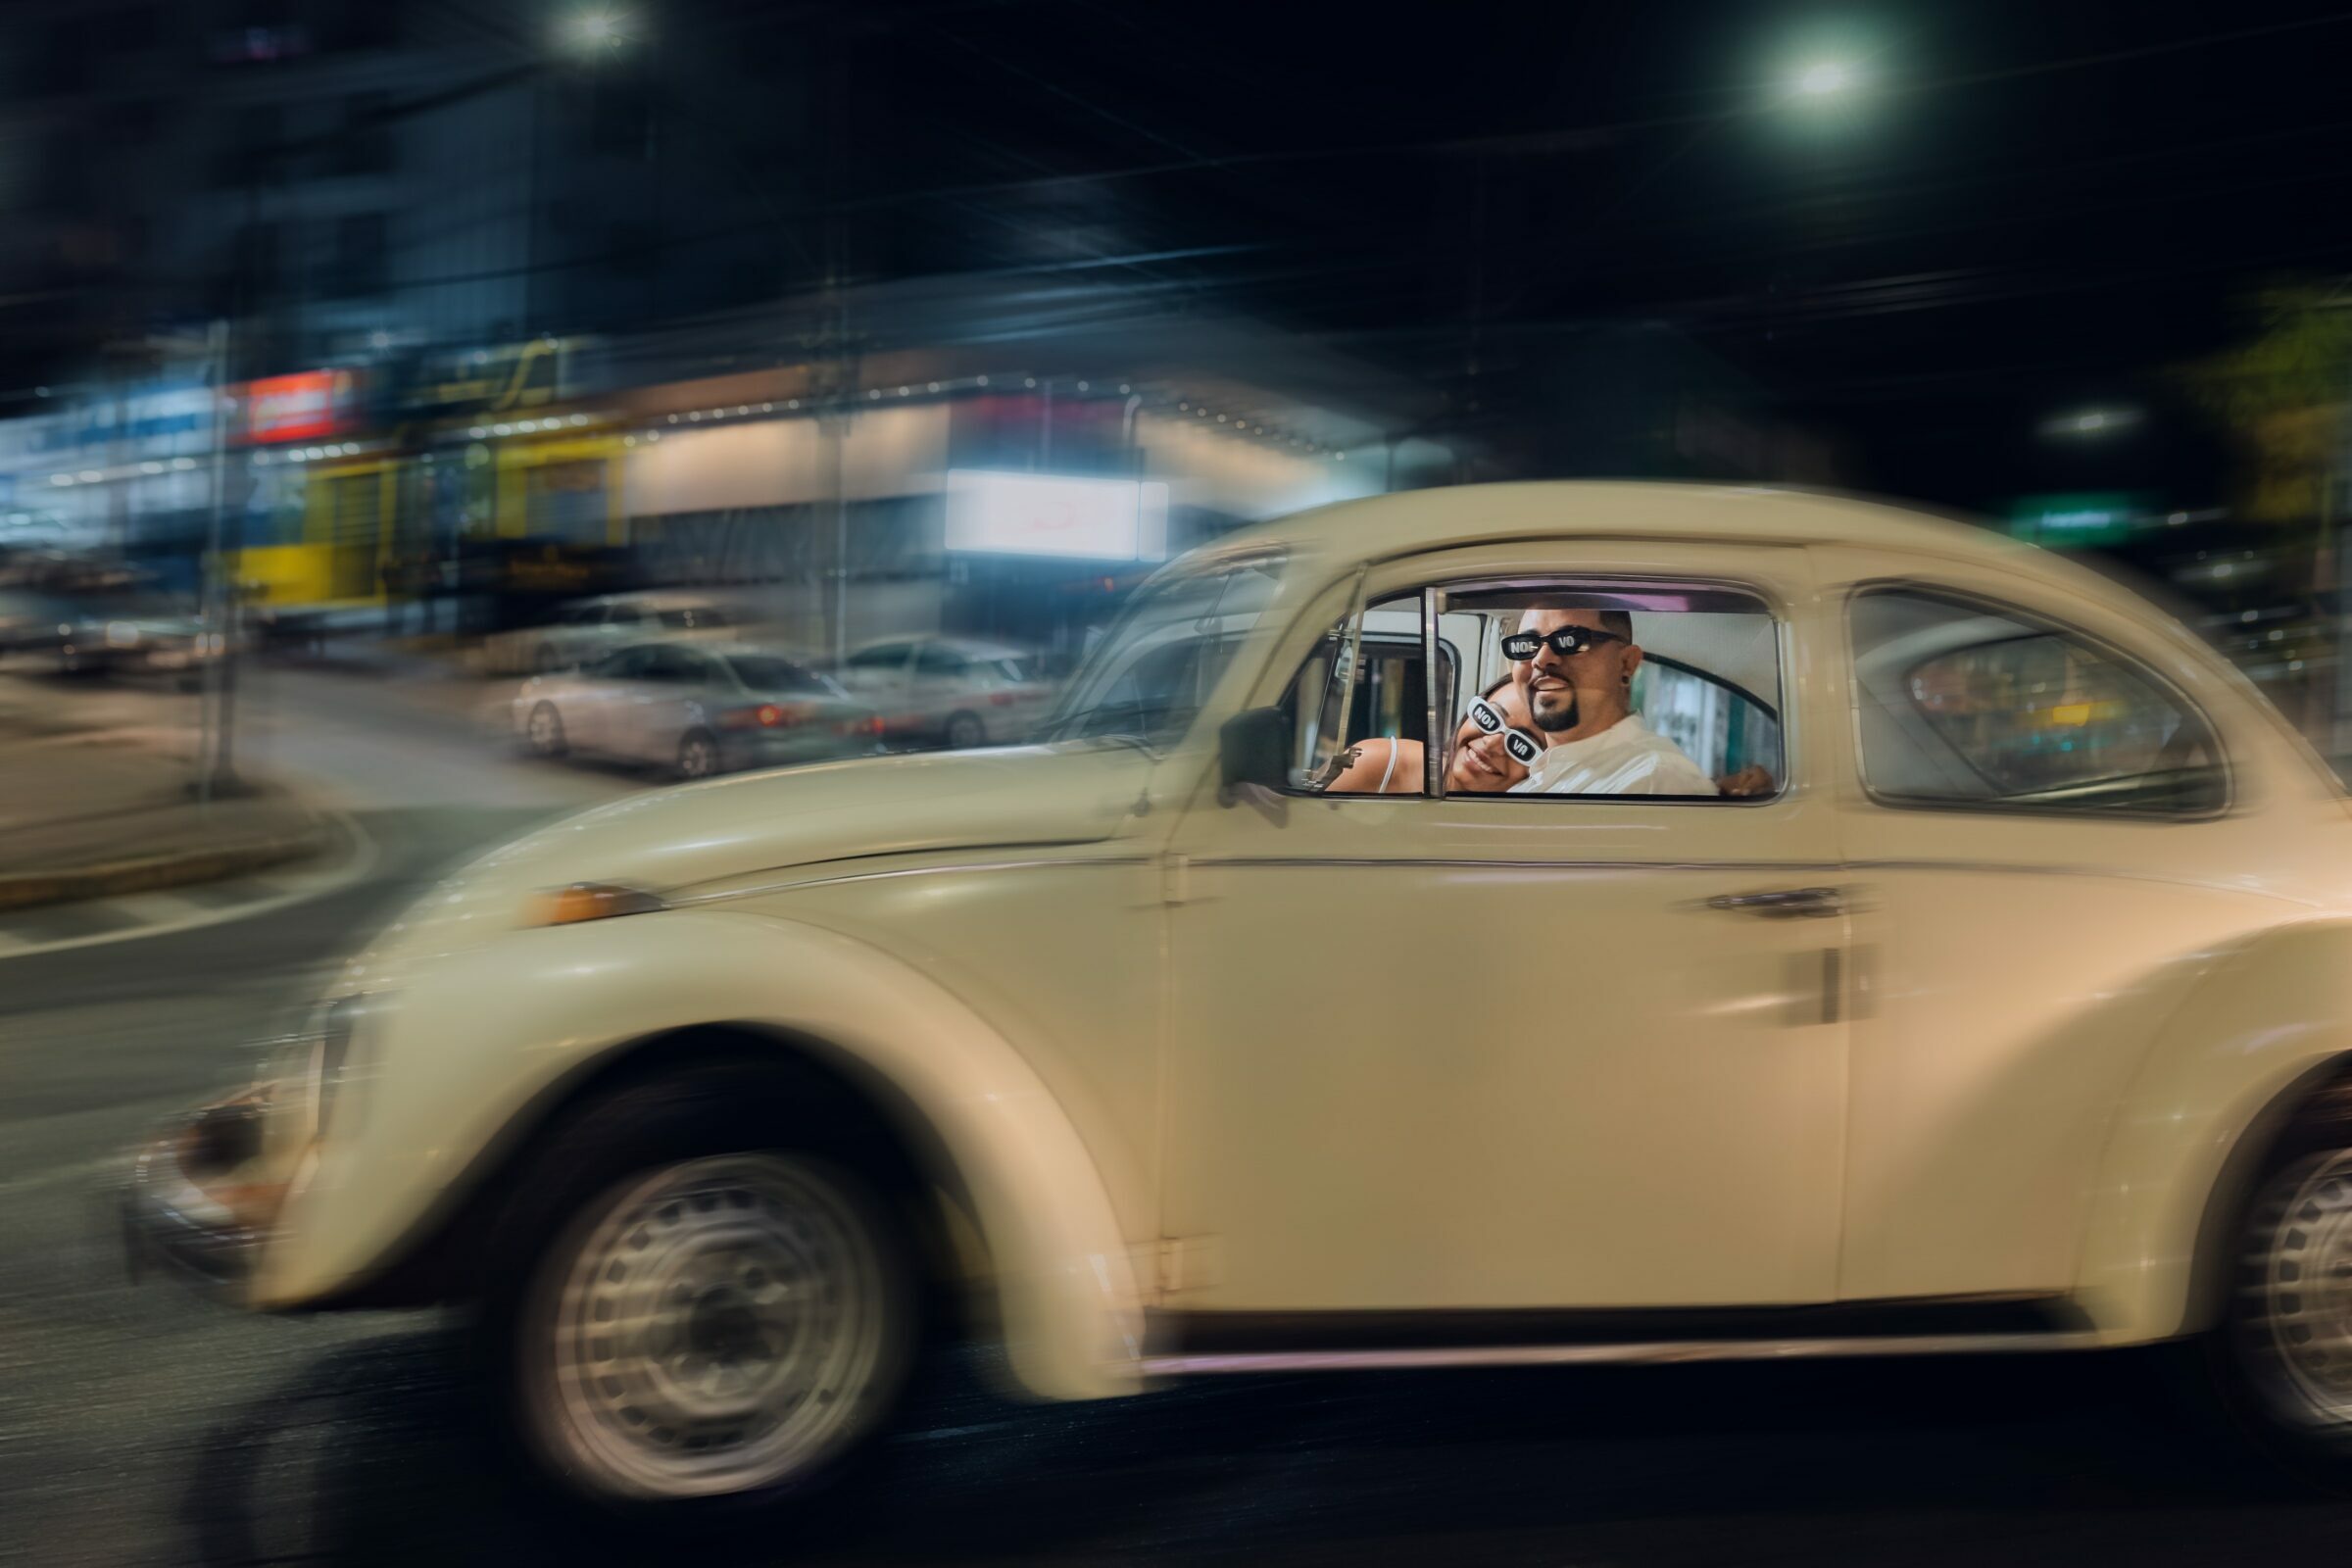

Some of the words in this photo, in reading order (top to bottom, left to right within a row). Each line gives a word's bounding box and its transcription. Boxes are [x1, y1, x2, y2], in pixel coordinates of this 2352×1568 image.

[1558, 635, 1575, 648] VO
[1474, 706, 1496, 729] NOI
[1513, 739, 1529, 756] VA
